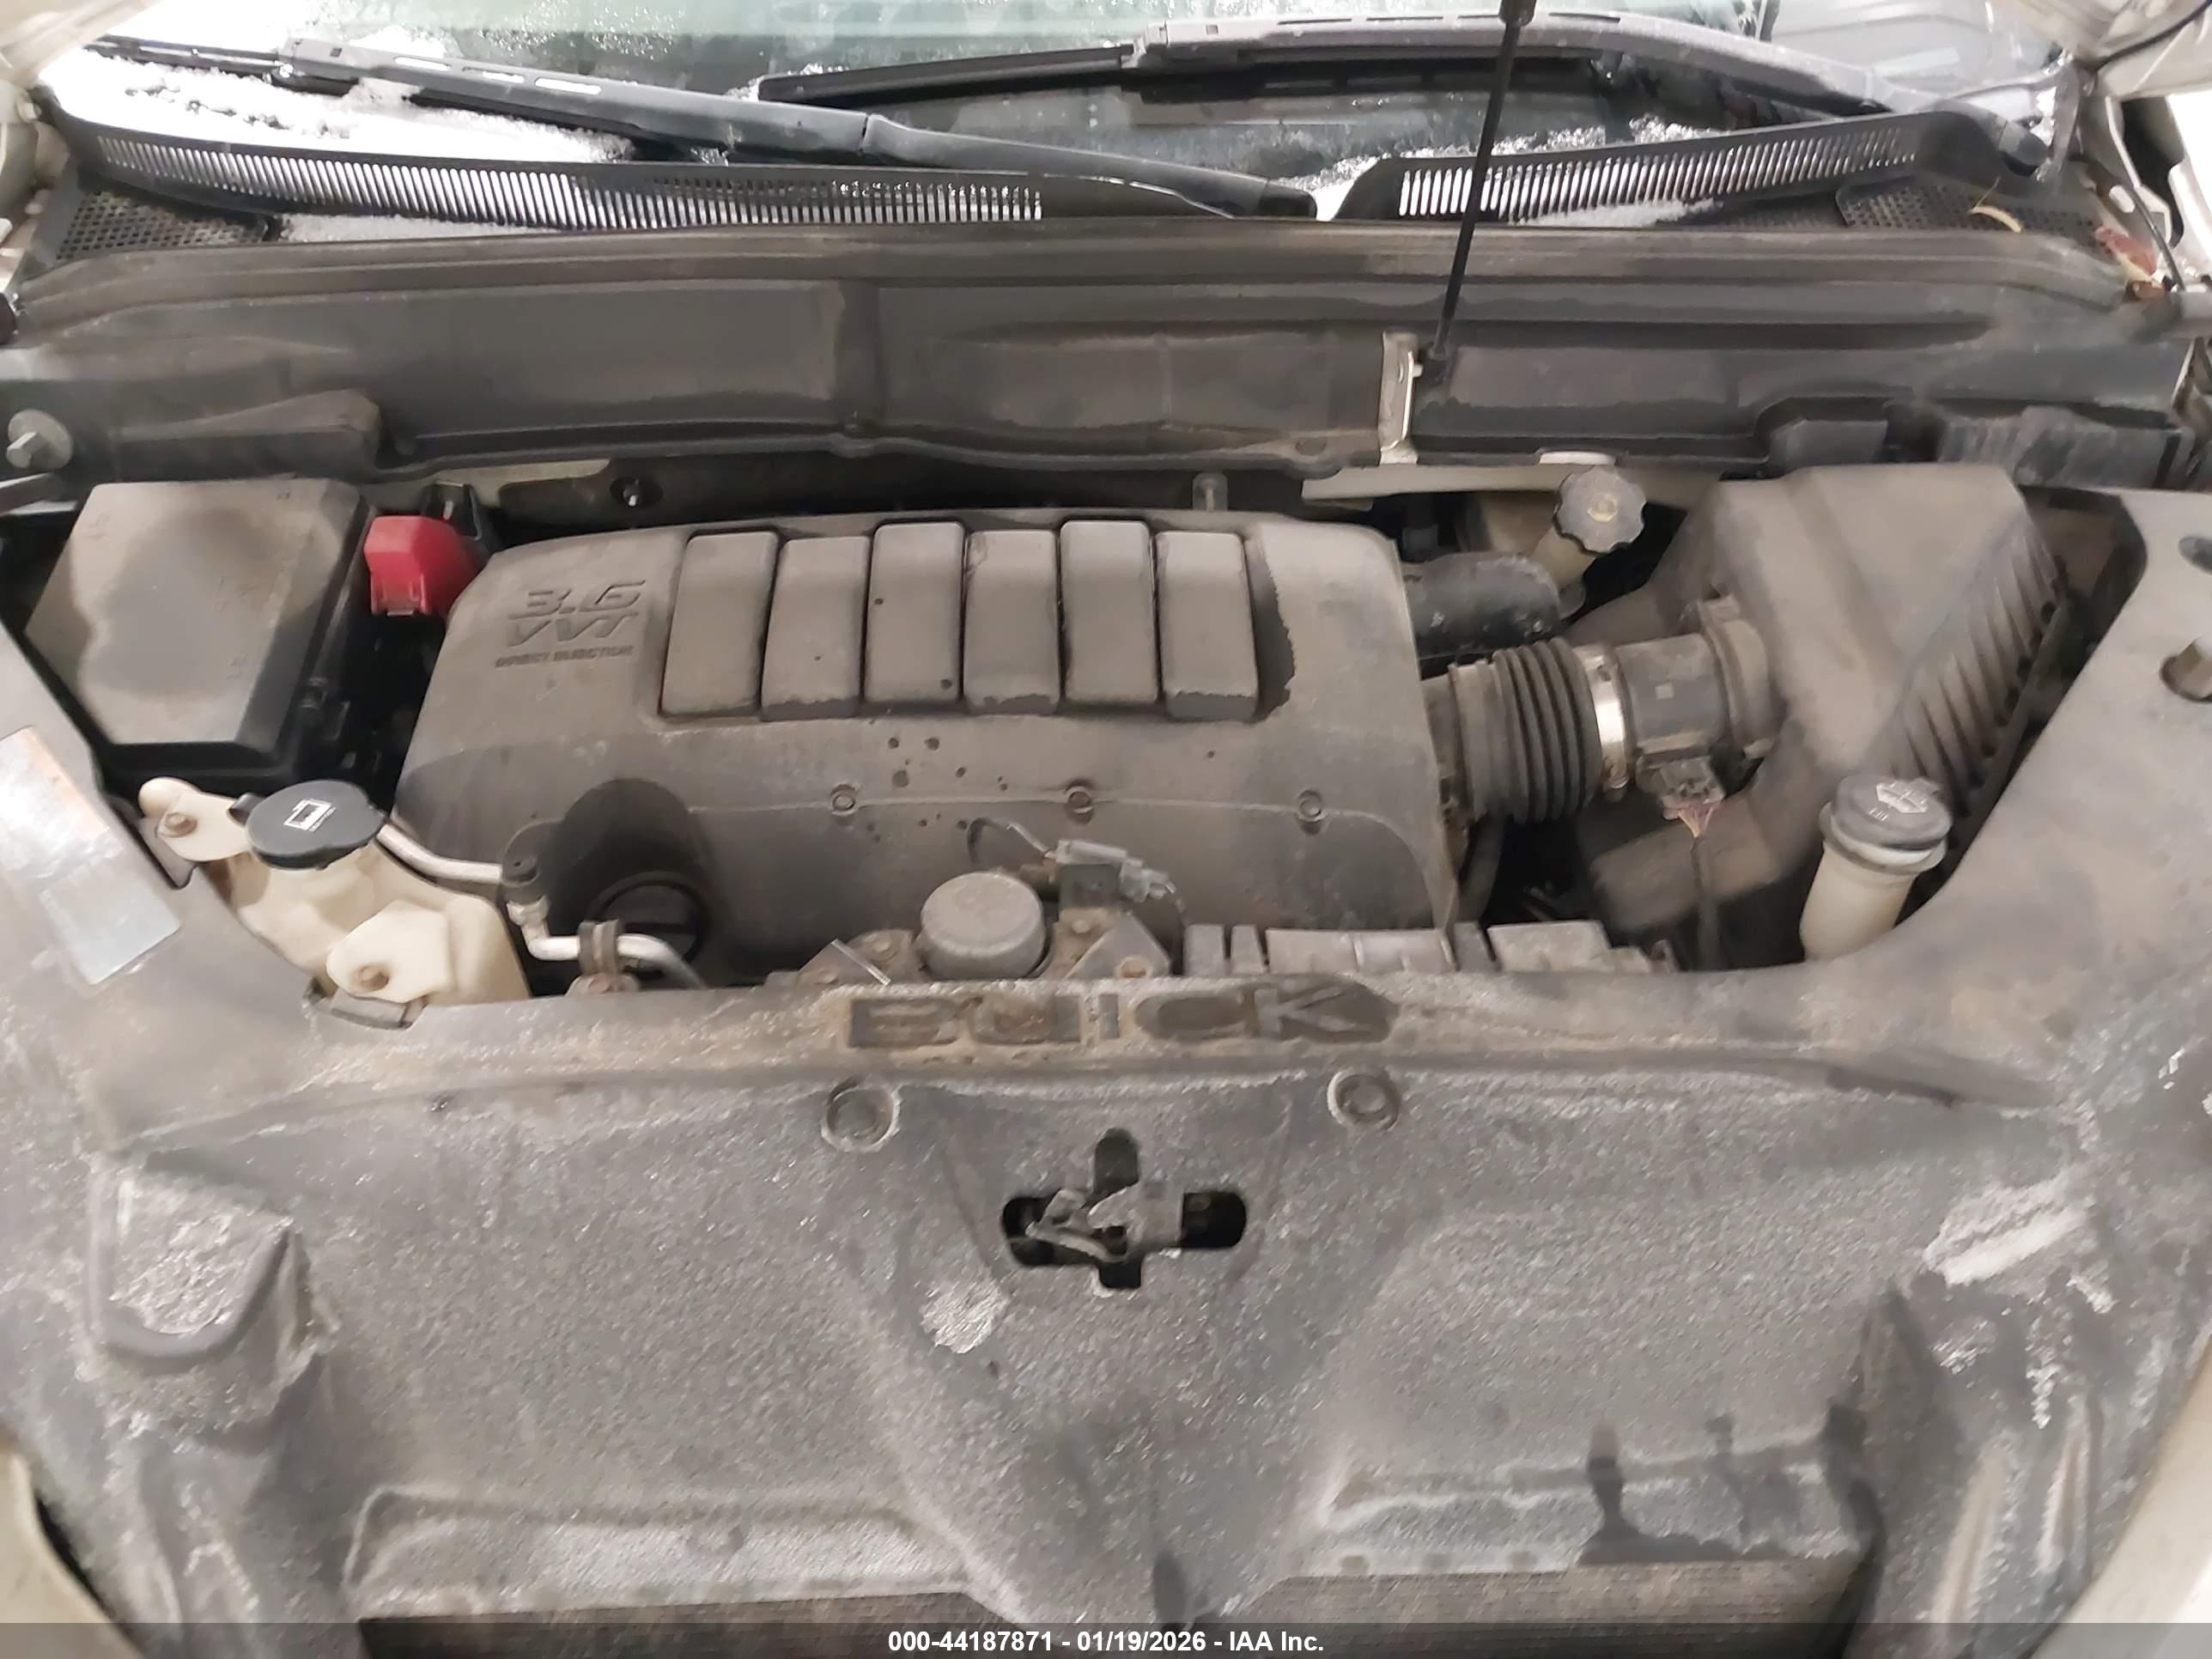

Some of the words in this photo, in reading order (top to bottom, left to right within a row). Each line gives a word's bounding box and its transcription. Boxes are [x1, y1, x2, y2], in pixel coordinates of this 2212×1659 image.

[507, 579, 647, 621] 3.6
[507, 611, 640, 648] VVT
[848, 976, 1398, 1048] BUICK
